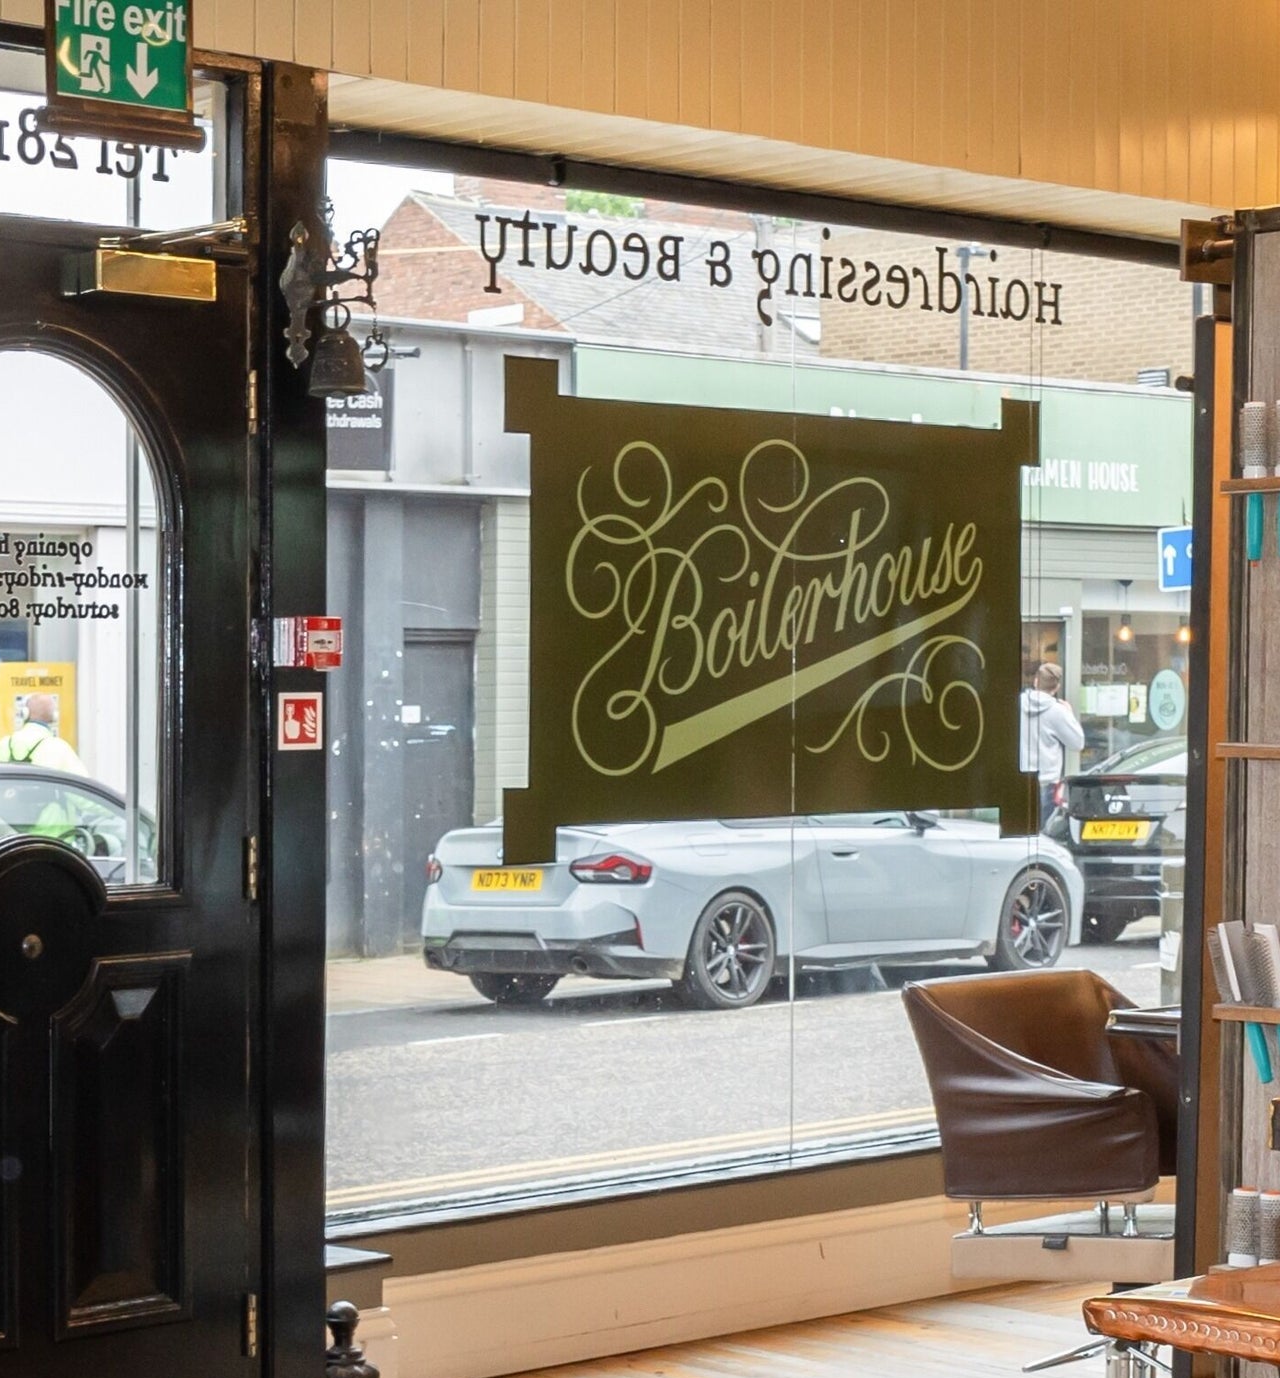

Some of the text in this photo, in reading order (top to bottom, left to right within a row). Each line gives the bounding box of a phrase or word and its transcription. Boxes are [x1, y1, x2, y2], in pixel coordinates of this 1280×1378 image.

[123, 1, 186, 42] exit
[347, 391, 383, 409] Cash
[1088, 462, 1140, 492] HOUSE
[615, 480, 983, 700] Boilerhouse
[11, 675, 64, 687] TRAVEL MONEY
[477, 871, 536, 888] ND73 YNR
